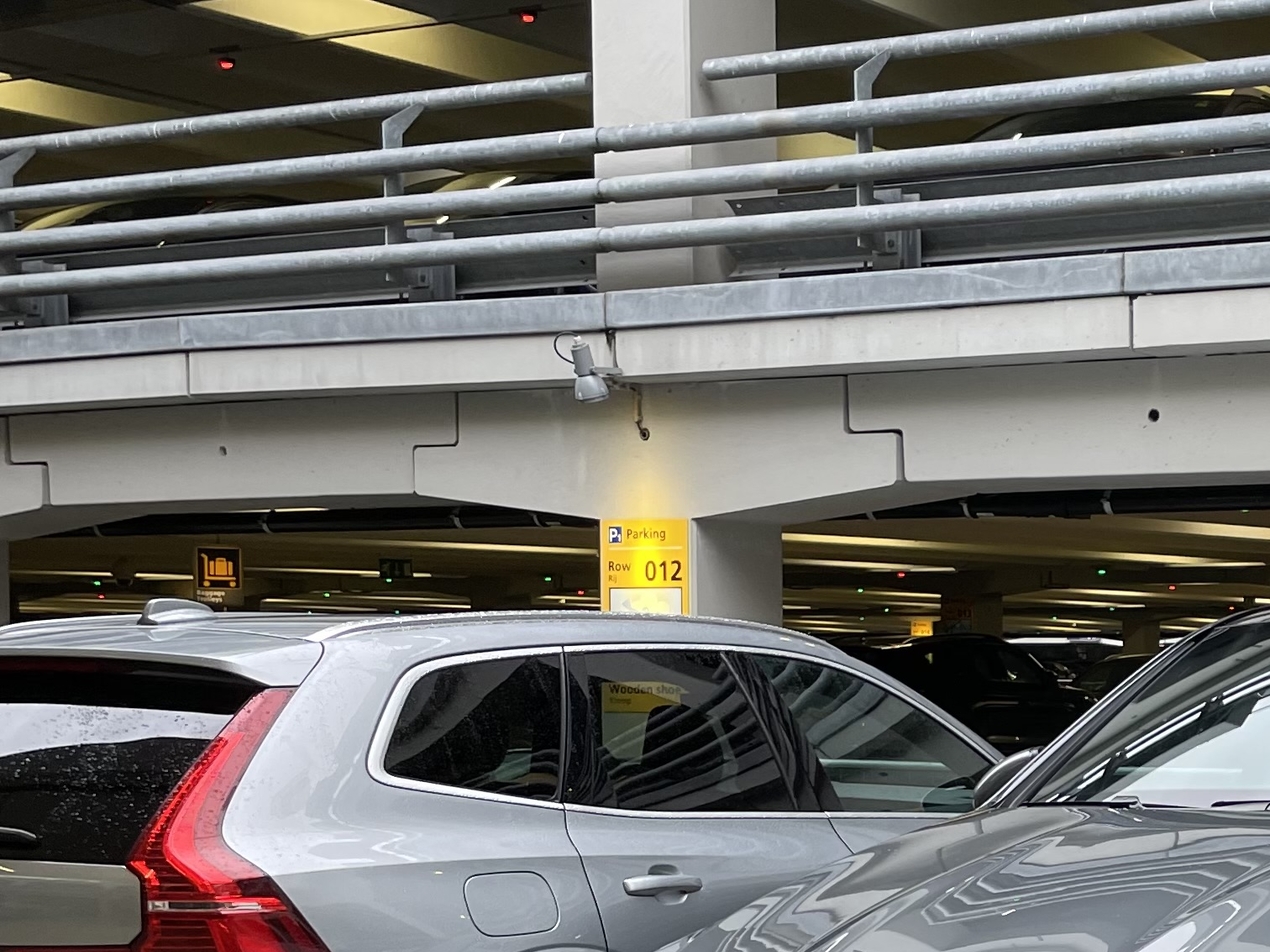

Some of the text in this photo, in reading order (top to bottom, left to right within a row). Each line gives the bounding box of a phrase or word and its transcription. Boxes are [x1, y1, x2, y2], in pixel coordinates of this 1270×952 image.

[626, 527, 666, 541] Parking
[608, 560, 682, 581] Row 012
[609, 683, 653, 694] Wooden
